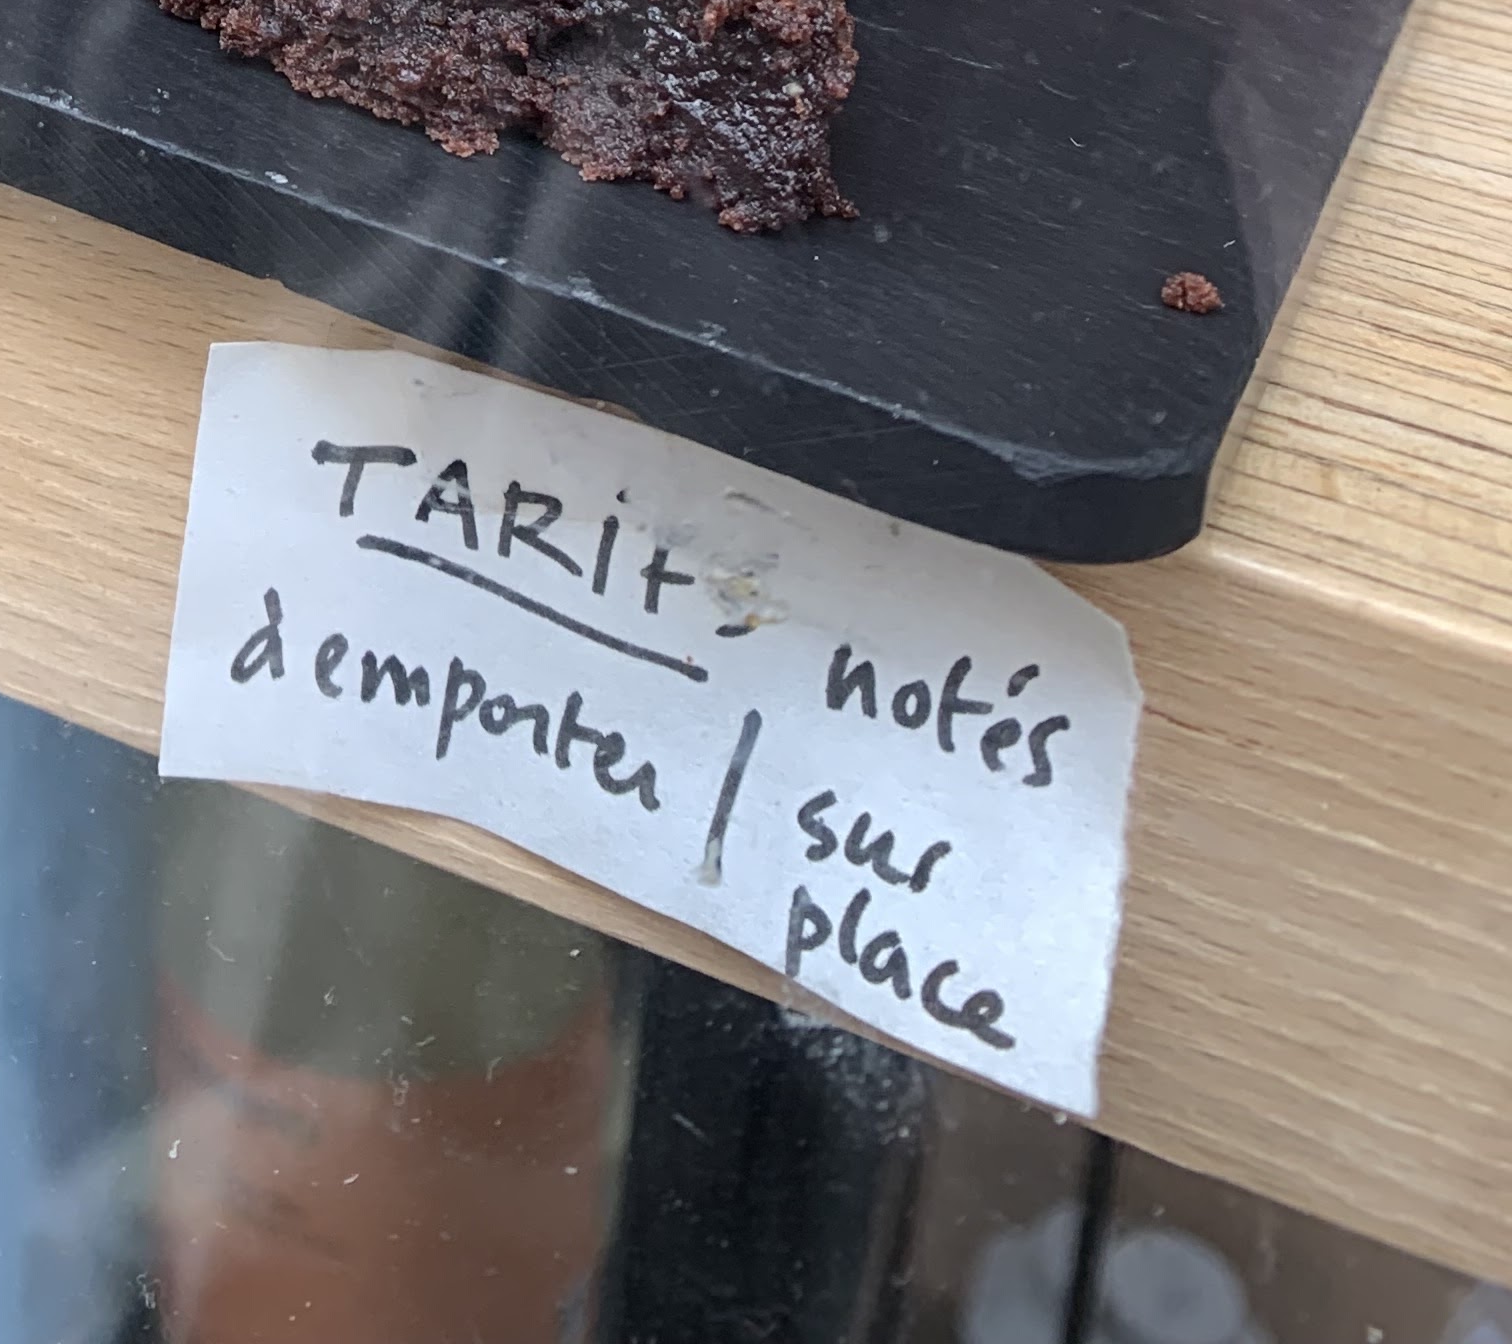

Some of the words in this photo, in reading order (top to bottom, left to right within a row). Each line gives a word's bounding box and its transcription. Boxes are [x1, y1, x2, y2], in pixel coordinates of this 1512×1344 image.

[314, 632, 662, 811] emporter
[796, 789, 952, 893] sur
[825, 643, 1070, 787] notés
[785, 884, 1016, 1051] place
